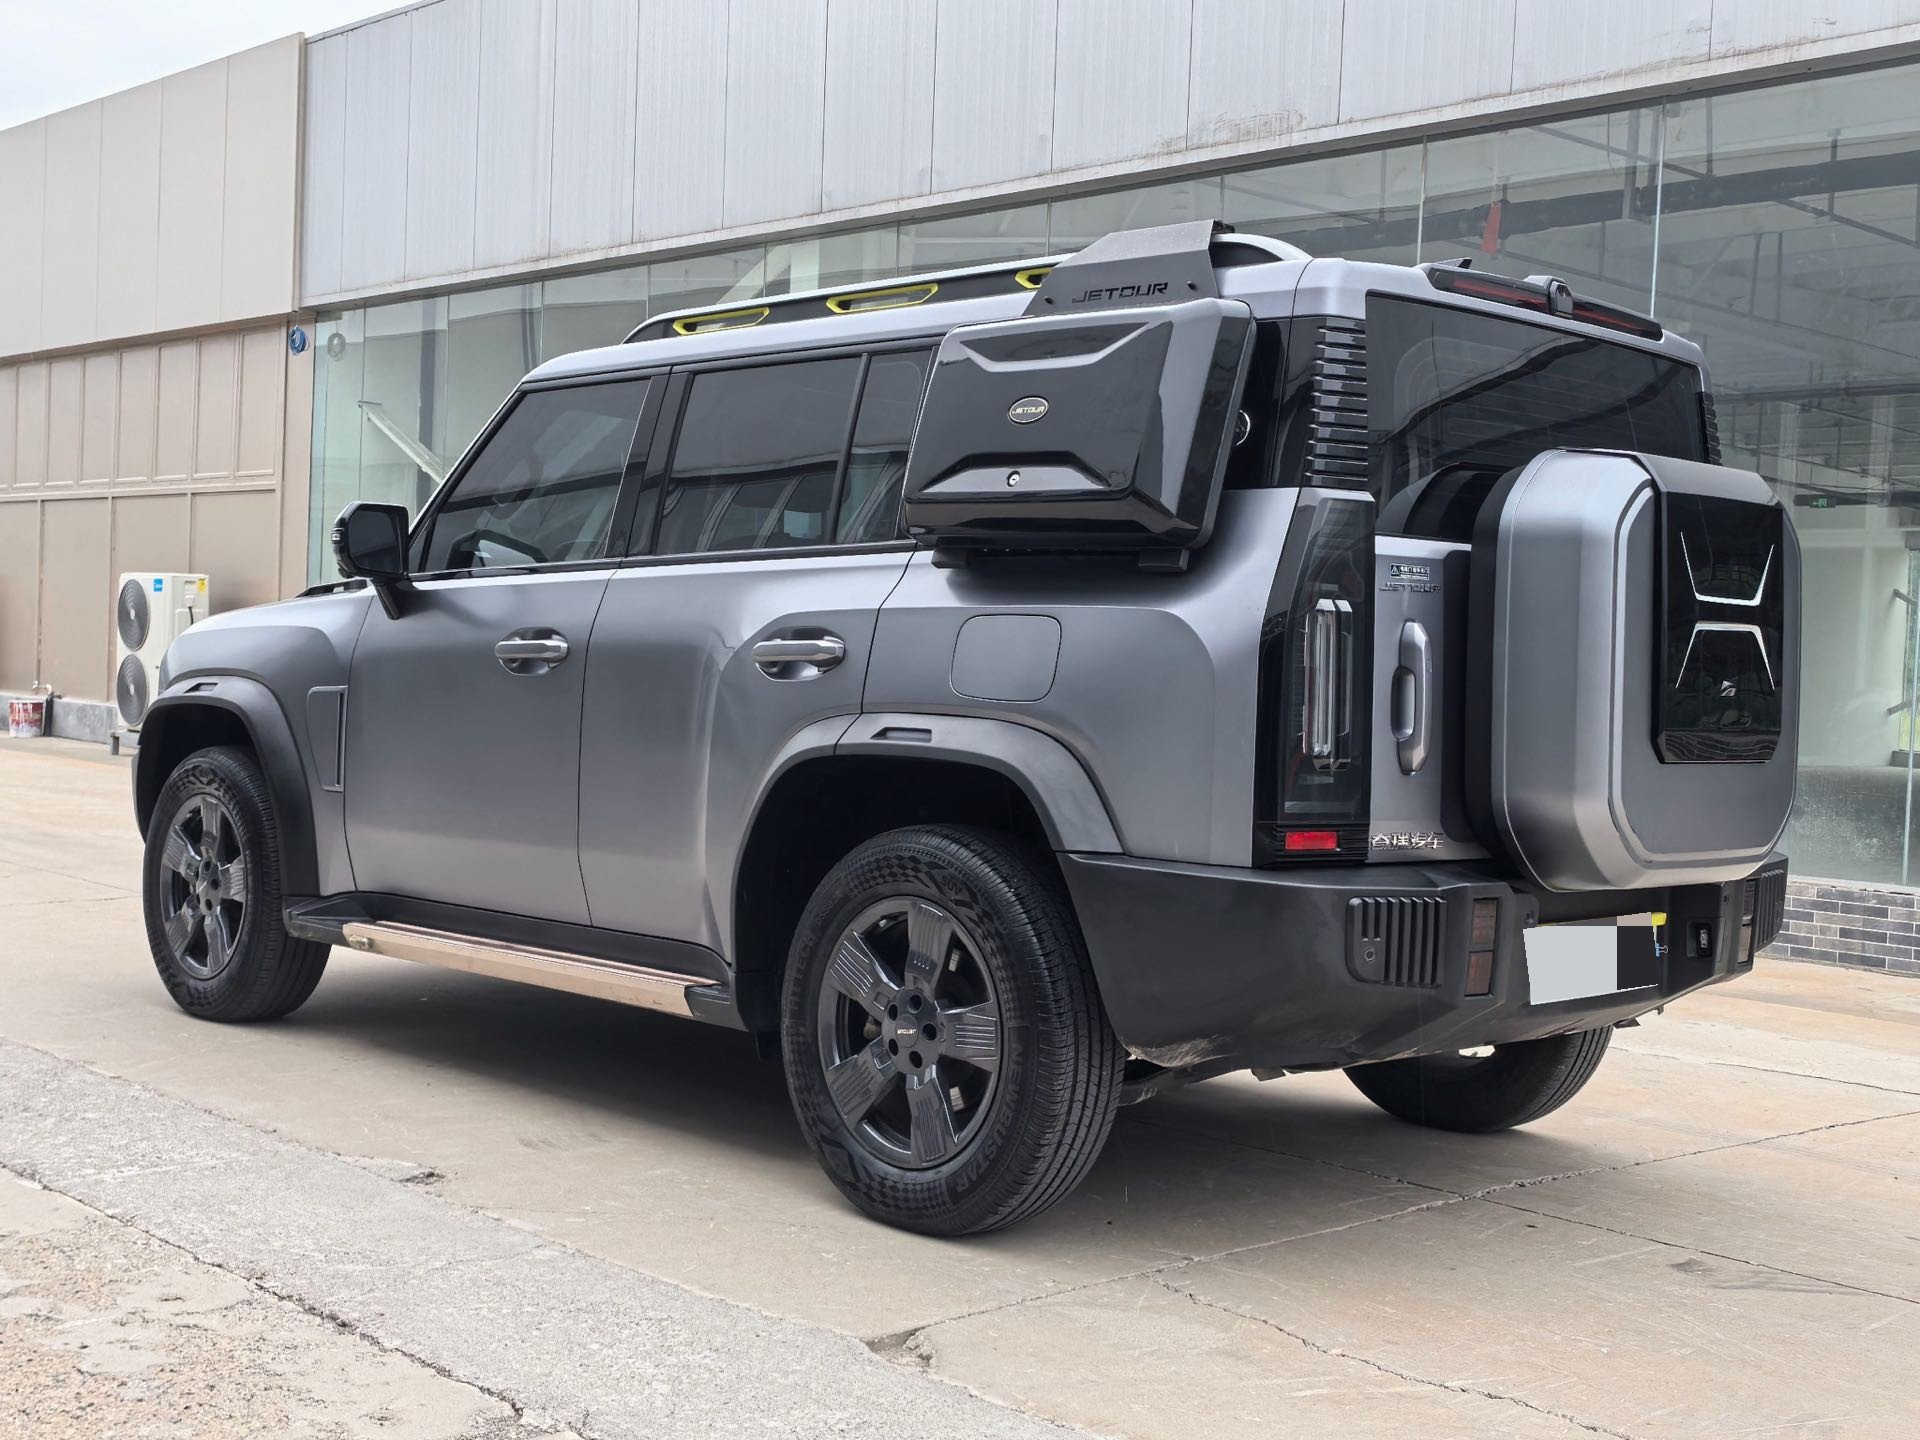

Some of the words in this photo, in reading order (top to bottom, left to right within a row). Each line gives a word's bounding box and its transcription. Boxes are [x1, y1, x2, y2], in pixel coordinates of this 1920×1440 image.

[1071, 281, 1169, 304] JETOUR
[1011, 405, 1046, 414] JETOUR
[1378, 582, 1441, 593] JETOUR
[1371, 831, 1444, 850] 奇瑞汽车
